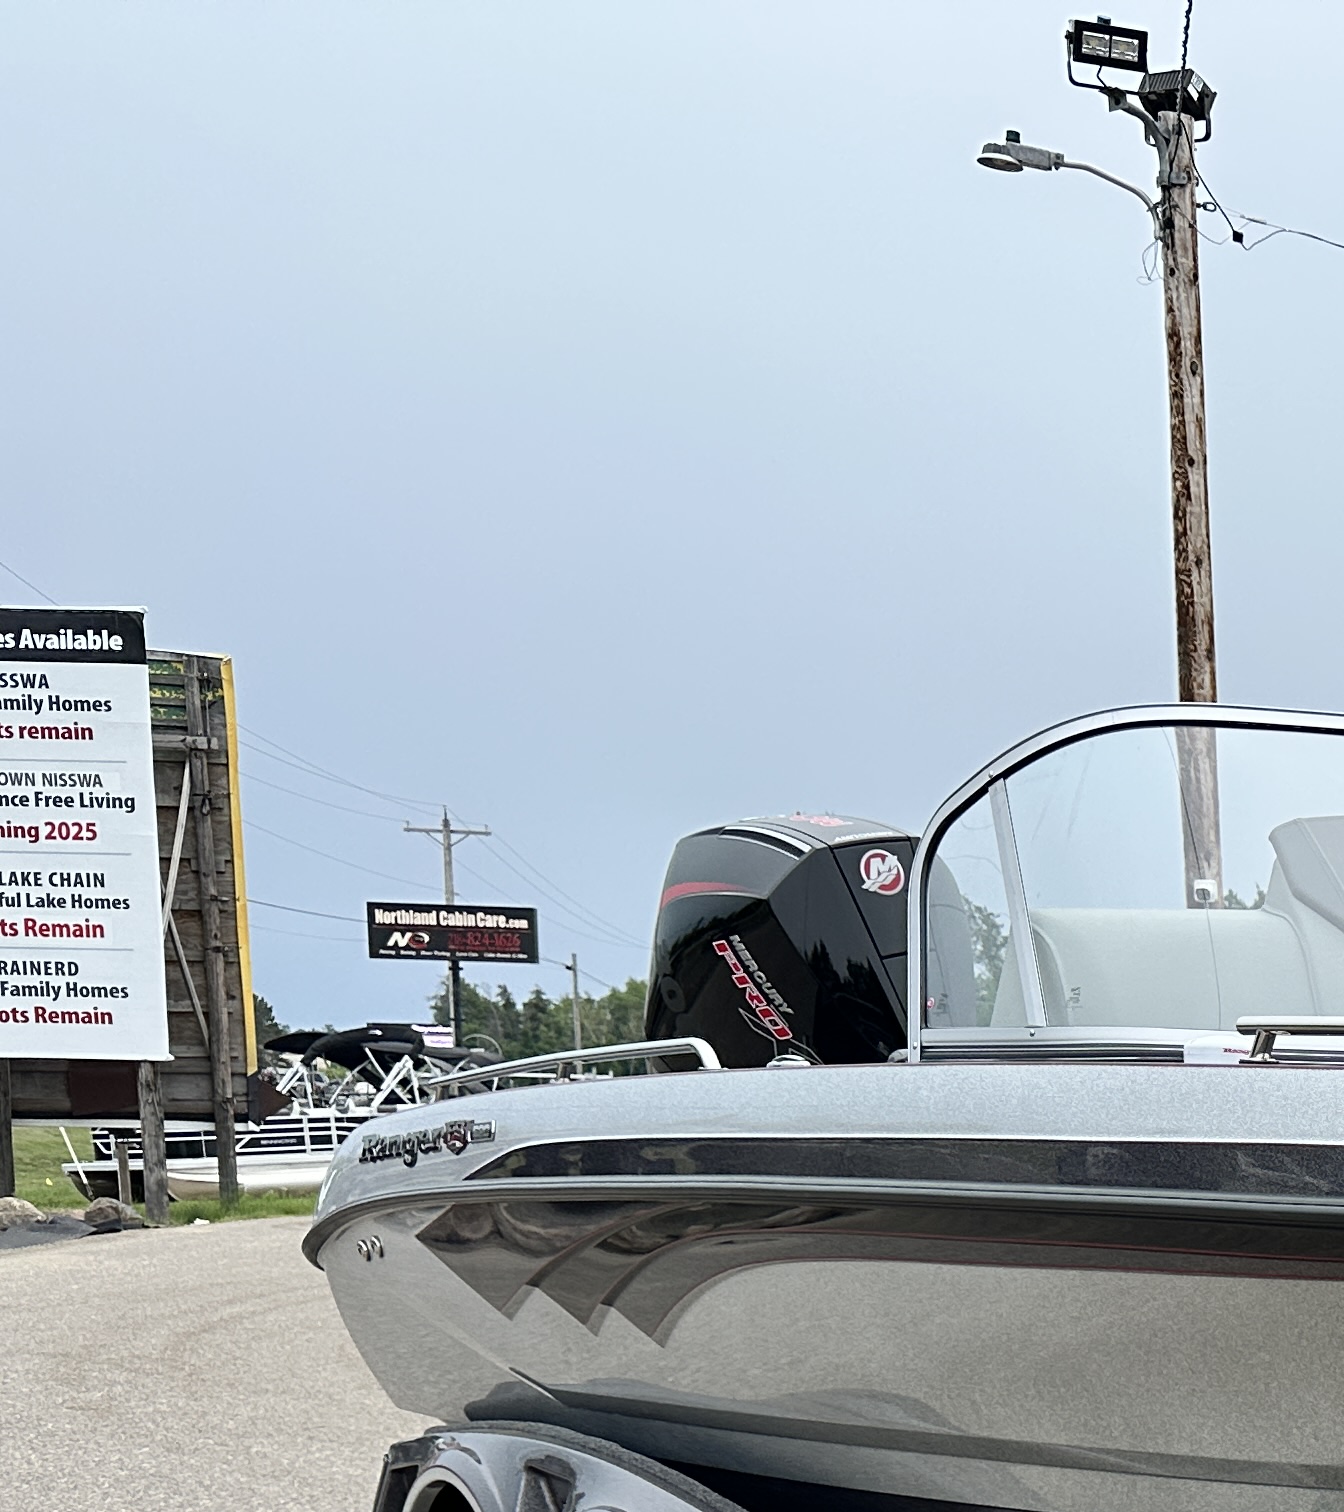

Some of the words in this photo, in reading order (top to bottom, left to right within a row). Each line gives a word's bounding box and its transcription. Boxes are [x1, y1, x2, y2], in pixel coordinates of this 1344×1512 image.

[19, 629, 123, 650] Available
[0, 673, 49, 689] SSWA
[0, 694, 43, 715] mily
[48, 695, 112, 712] Homes
[19, 722, 94, 740] remain
[0, 772, 36, 787] OWN
[42, 773, 103, 788] NISSWA
[0, 794, 30, 807] nce
[34, 791, 75, 808] Free
[79, 792, 136, 813] Living
[44, 821, 98, 841] 2025
[0, 871, 43, 887] LAKE
[48, 872, 105, 888] CHAIN
[0, 891, 21, 908] ful
[26, 892, 67, 908] Lake
[71, 894, 130, 910] Homes
[374, 908, 438, 926] Northland
[0, 918, 19, 937] ts
[24, 918, 105, 938] Remain
[0, 960, 79, 976] RAINERD
[729, 934, 795, 1015] MERCURY
[1, 980, 62, 1001] Family
[66, 982, 129, 998] Homes
[712, 940, 793, 1040] PRO
[0, 1007, 30, 1023] ots
[34, 1006, 114, 1025] Remain
[359, 1127, 444, 1168] Ranger
